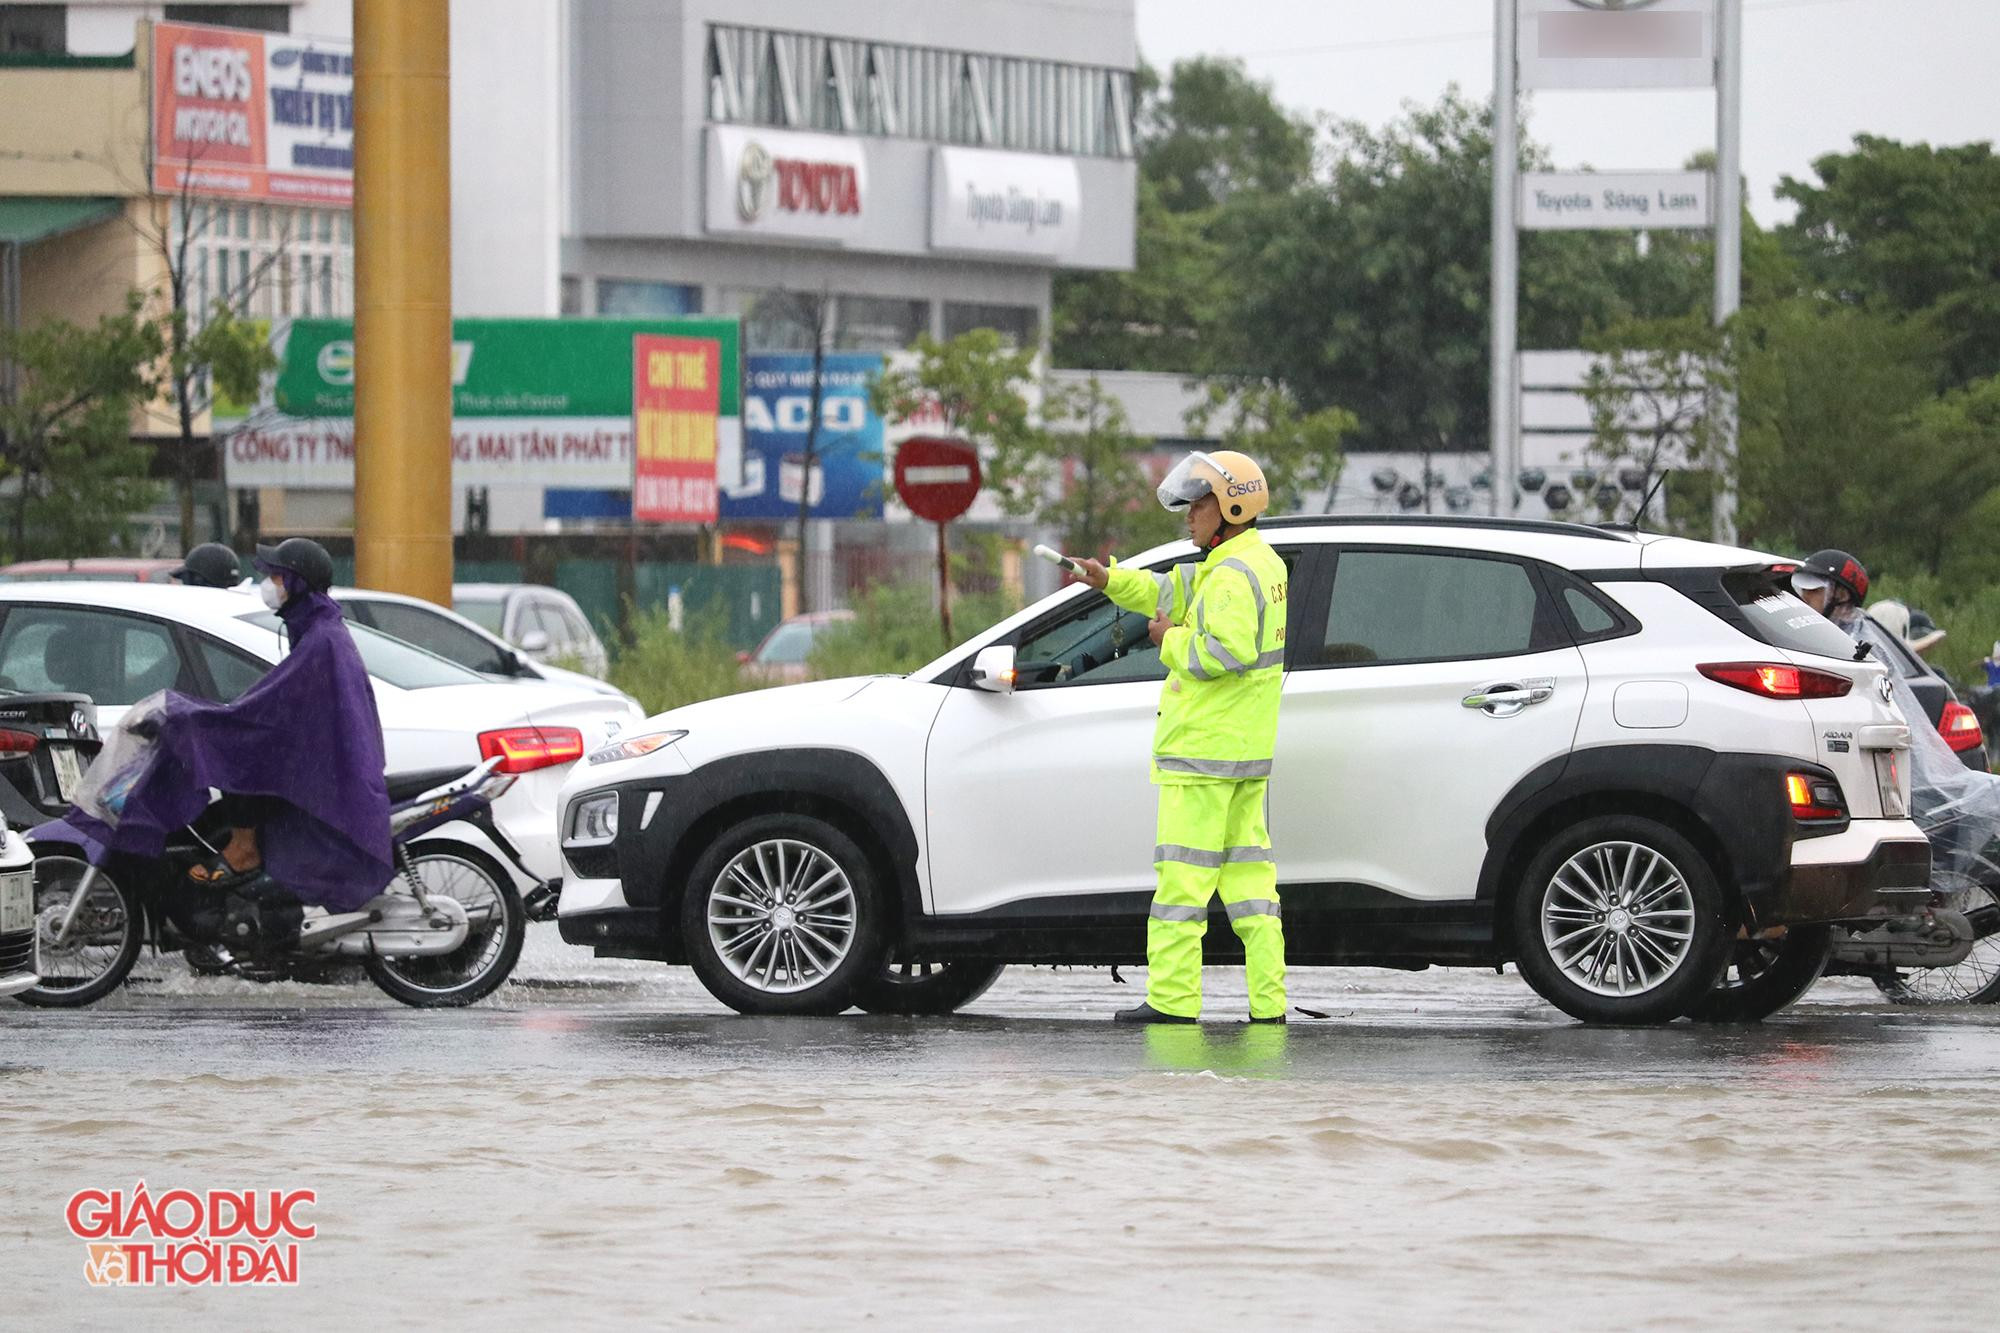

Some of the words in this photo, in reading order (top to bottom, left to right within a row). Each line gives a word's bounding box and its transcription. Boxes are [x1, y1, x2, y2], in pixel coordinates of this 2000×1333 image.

[175, 45, 251, 102] ENEOS
[773, 156, 860, 217] TOYOTA
[1535, 189, 1592, 216] Toyota
[1602, 187, 1649, 215] Sông
[1658, 189, 1698, 210] Lam
[966, 181, 1004, 228] Toyota
[1005, 184, 1036, 236] Sông
[1036, 188, 1063, 227] Lam
[744, 395, 865, 433] ACO
[297, 435, 319, 463] TY
[1227, 478, 1263, 498] CSGT
